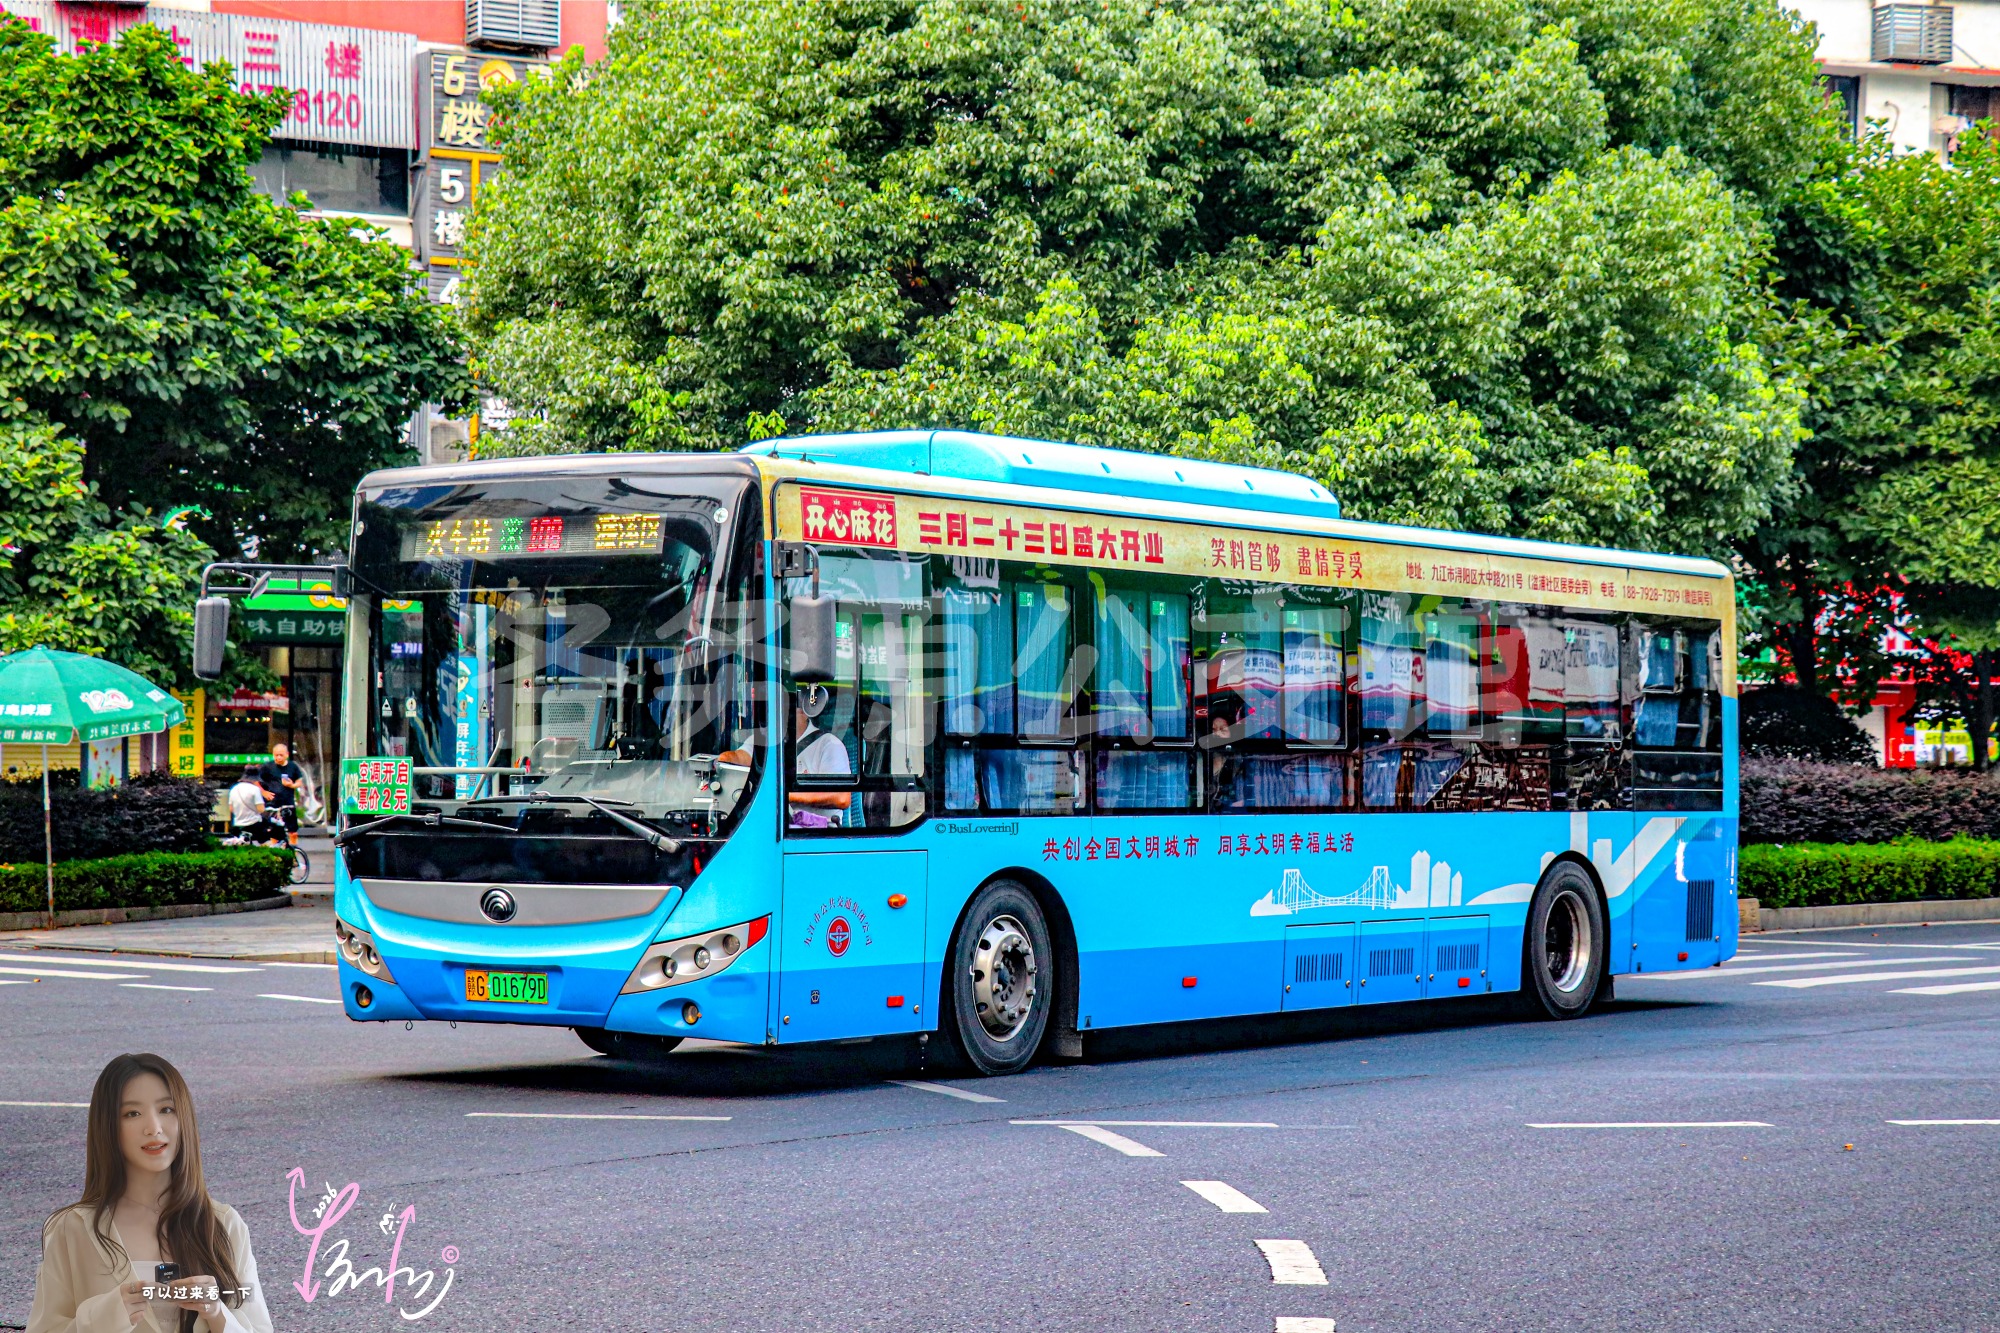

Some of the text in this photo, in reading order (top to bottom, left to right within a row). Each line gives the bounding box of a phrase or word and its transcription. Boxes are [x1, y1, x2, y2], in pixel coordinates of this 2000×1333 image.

[805, 504, 893, 544] 开心麻花
[918, 511, 1164, 564] 三月二十三日盛大开业
[1211, 537, 1281, 573] 笑料管够
[1297, 546, 1363, 579] 盡情享受
[359, 761, 409, 784] 空调开启
[358, 788, 407, 811] 票价2元
[1042, 832, 1355, 862] 共创全国文明城市 同享文明幸福生活
